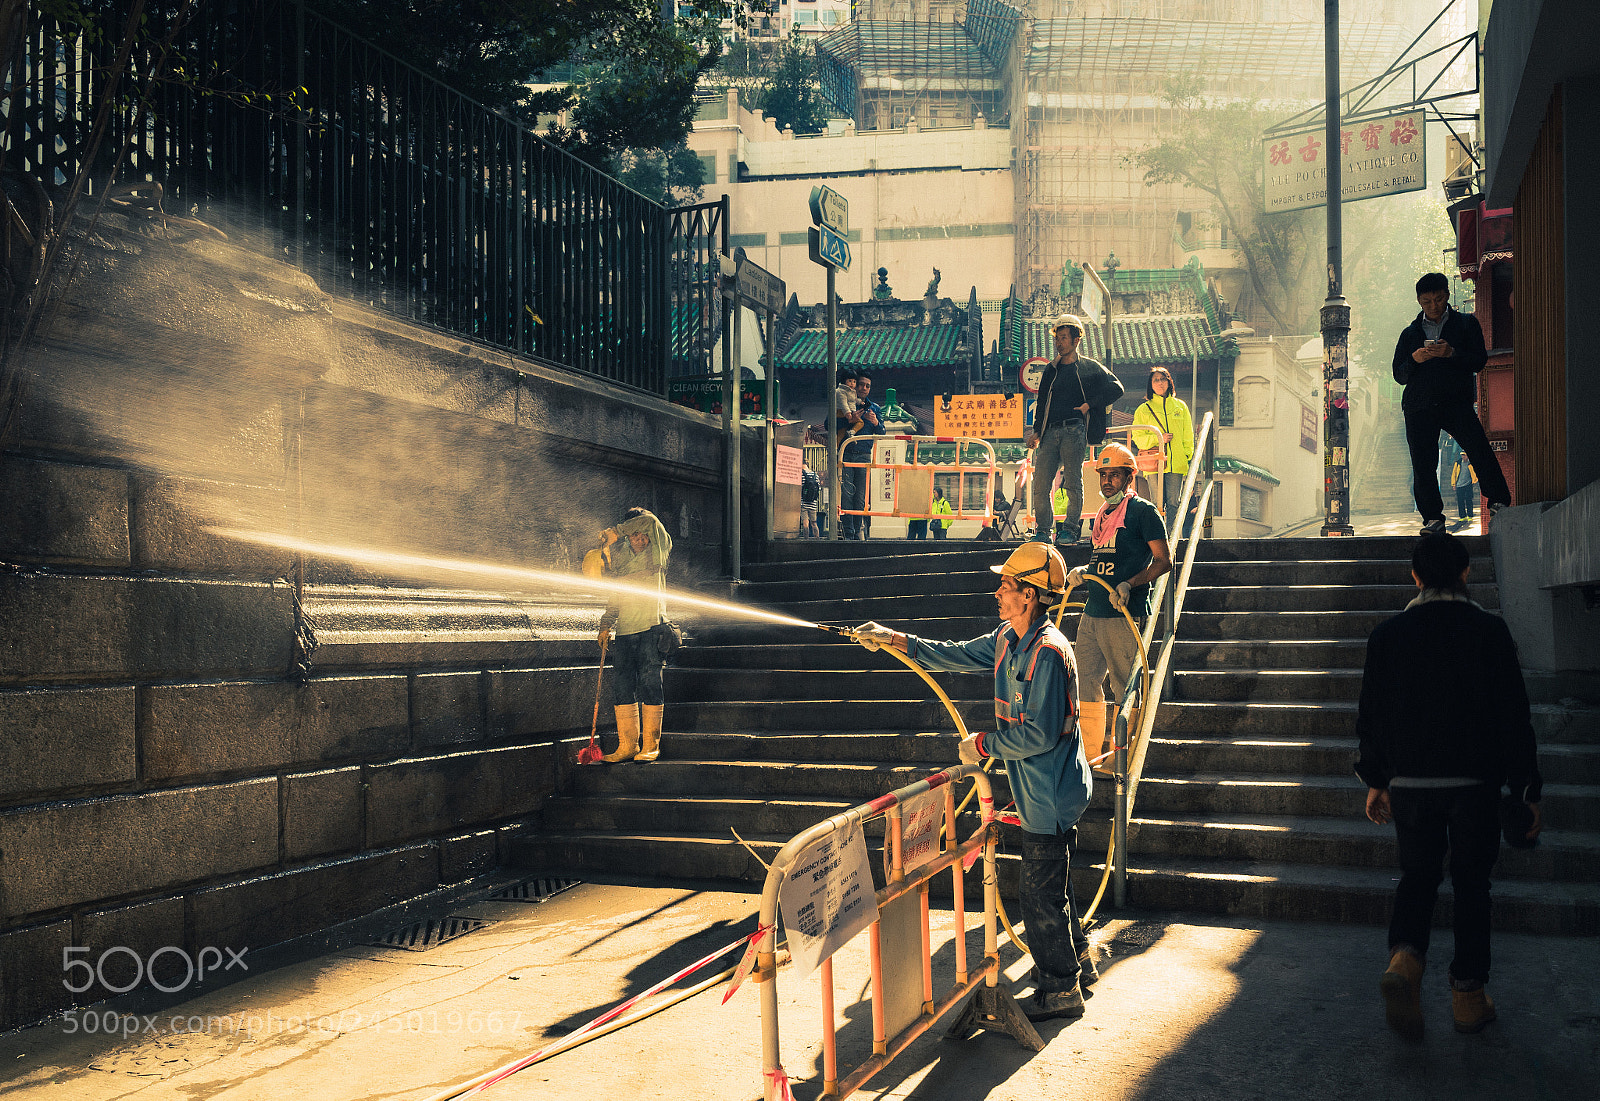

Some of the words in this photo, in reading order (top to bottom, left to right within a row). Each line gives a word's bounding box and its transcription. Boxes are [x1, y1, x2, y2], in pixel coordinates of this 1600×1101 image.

[1296, 171, 1309, 182] PO
[1347, 155, 1396, 172] ANTIQUE
[1271, 196, 1295, 206] IMPORT
[1392, 175, 1416, 186] RETAIL
[673, 383, 699, 392] CLEAN
[1097, 561, 1115, 576] 02
[790, 859, 819, 881] EMERGENCY
